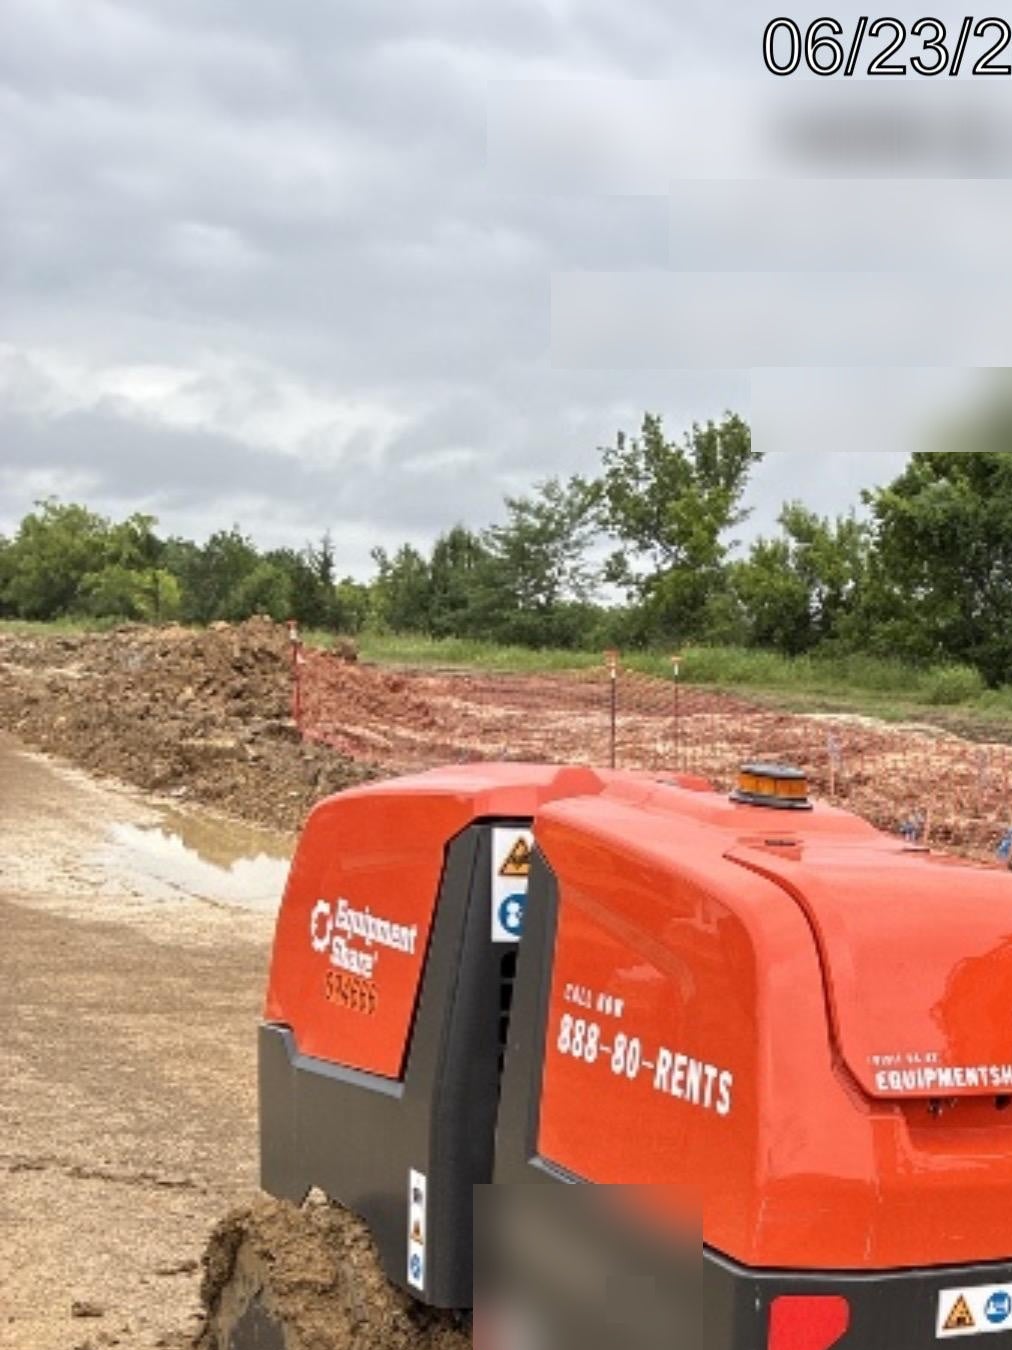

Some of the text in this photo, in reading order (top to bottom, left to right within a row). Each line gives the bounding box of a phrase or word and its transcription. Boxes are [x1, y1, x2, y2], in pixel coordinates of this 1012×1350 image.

[335, 898, 417, 955] Equipment
[329, 935, 374, 979] Share
[557, 1013, 733, 1116] 888-80-RENTS
